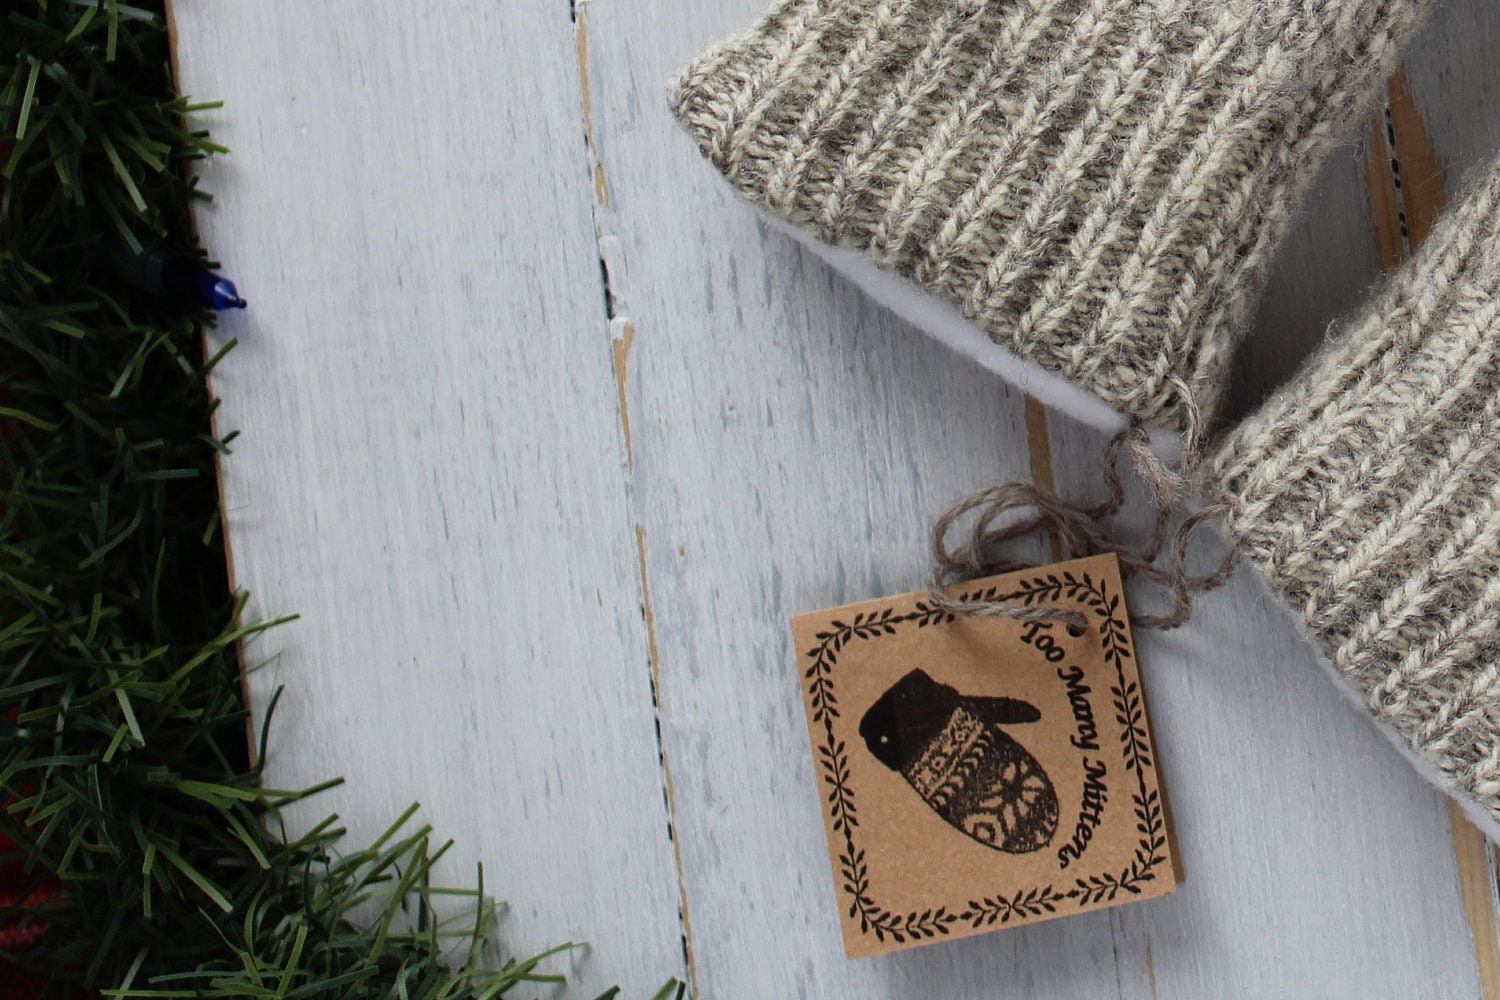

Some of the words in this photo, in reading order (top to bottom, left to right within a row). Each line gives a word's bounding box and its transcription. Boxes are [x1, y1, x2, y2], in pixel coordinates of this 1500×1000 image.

[1019, 620, 1066, 663] Too
[1058, 666, 1100, 751] Many
[1056, 755, 1111, 870] Mittens
